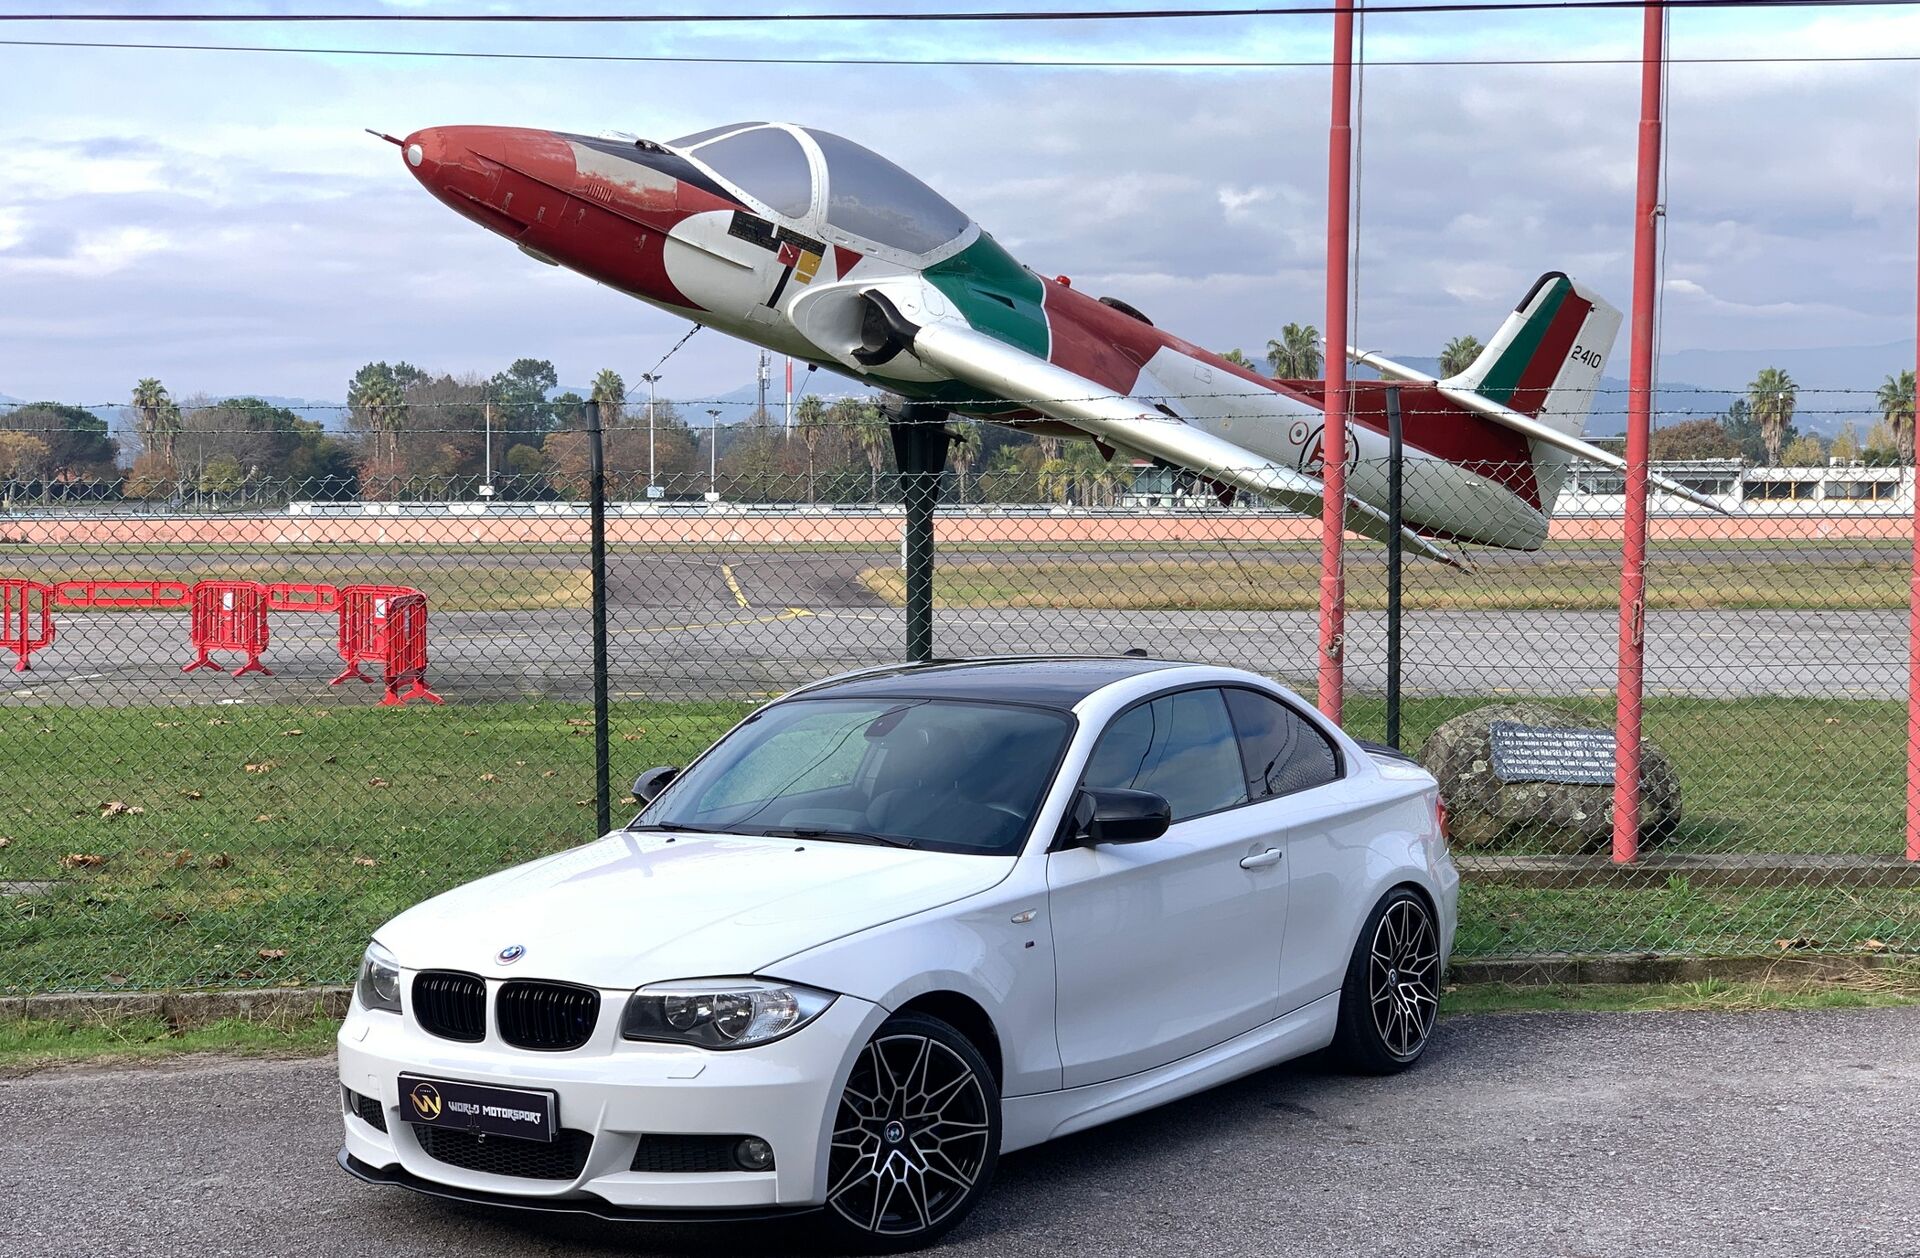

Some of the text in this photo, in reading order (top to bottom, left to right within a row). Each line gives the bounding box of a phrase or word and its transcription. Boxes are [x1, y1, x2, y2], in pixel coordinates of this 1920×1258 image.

[1571, 345, 1602, 368] 2410
[448, 1100, 542, 1124] WORLD MOTORSPORT
